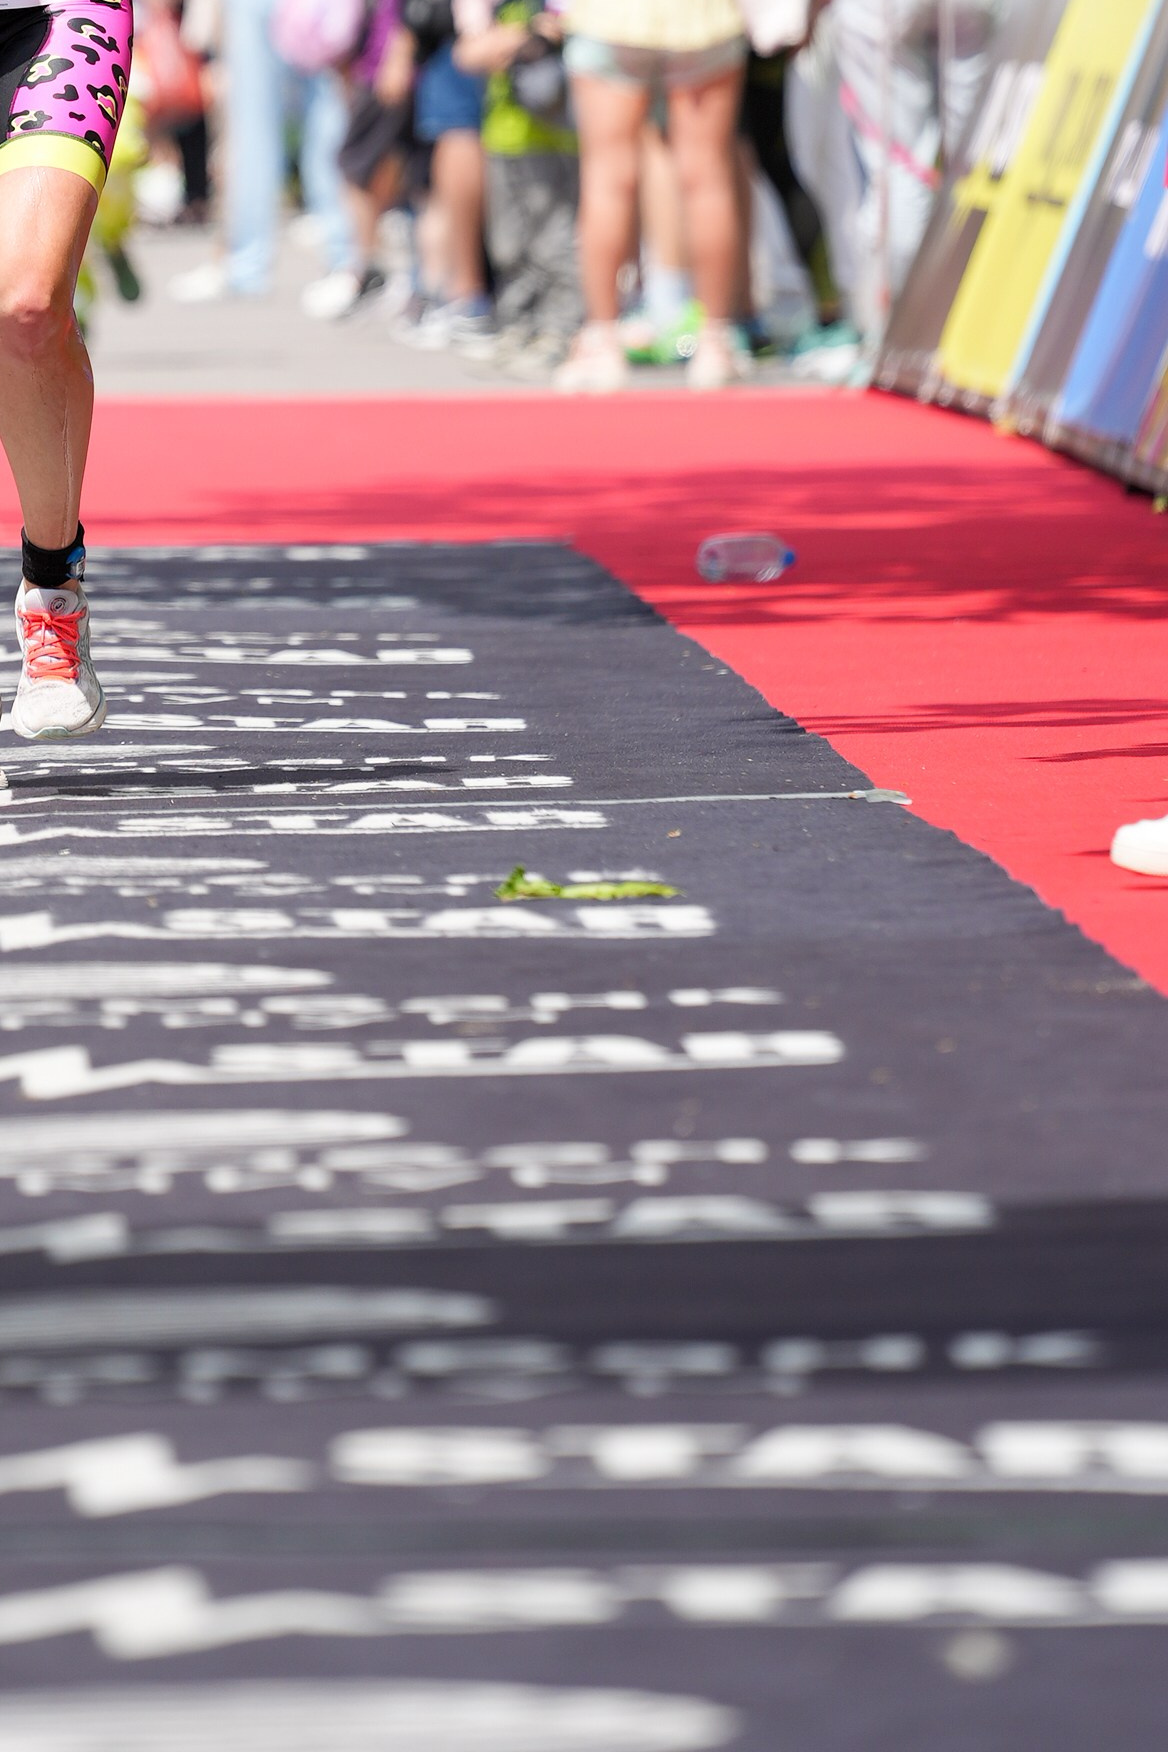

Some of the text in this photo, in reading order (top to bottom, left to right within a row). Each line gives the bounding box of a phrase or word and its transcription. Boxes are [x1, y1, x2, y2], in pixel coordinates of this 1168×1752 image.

[104, 714, 527, 729] STAR
[109, 776, 573, 795] STAR
[118, 812, 606, 831] STAR
[164, 905, 714, 932] STAR
[210, 1030, 843, 1072] STAR
